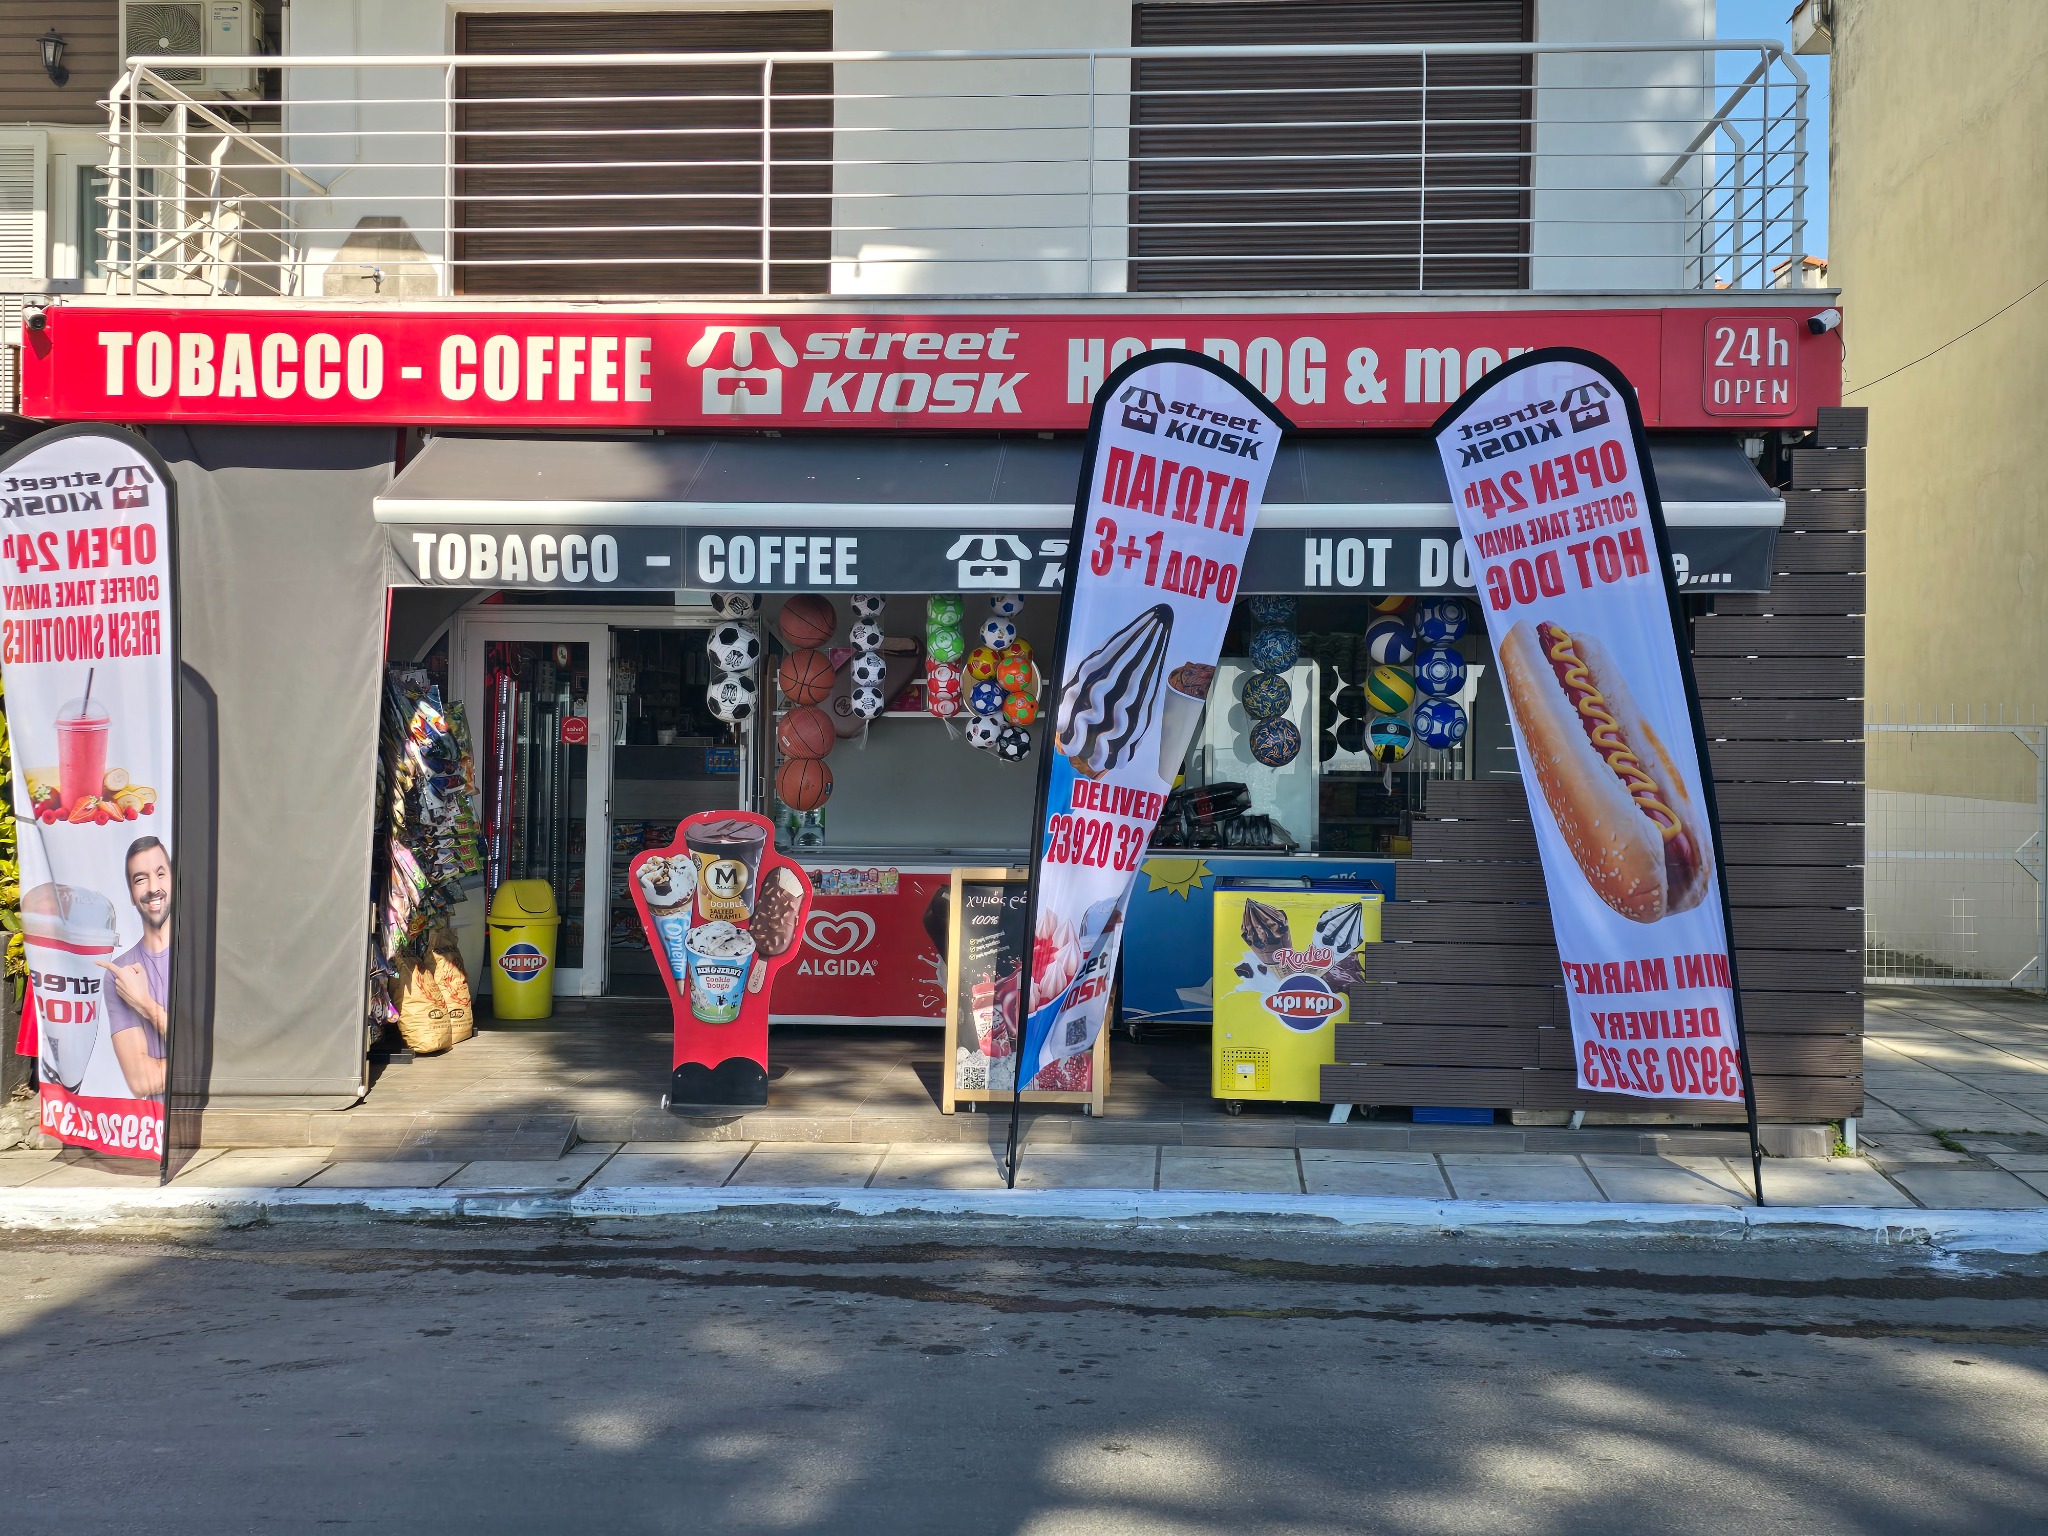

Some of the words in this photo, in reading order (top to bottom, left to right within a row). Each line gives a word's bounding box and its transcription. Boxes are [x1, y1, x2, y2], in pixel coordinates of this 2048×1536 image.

[803, 326, 1019, 360] street
[1714, 326, 1790, 368] 24h
[99, 330, 383, 400] TOBACCO
[440, 333, 652, 402] COFFEE
[1344, 347, 1387, 405] &
[802, 372, 1030, 414] KIOSK
[1713, 378, 1789, 405] OPEN
[1168, 400, 1262, 435] street
[1164, 419, 1264, 461] KIOSK
[1101, 446, 1250, 537] ΠΑΓΩΤΑ
[413, 533, 619, 583] TOBACCO
[698, 535, 858, 585] COFFEE
[1091, 516, 1165, 587] 3+1
[1161, 550, 1238, 604] ΔΩΡΟ
[1305, 538, 1392, 588] HOT
[1420, 538, 1477, 588] DO
[1071, 779, 1168, 822] DELIVER
[1047, 814, 1113, 869] 23920
[710, 900, 745, 908] DOUBLE
[971, 914, 999, 925] 100%
[797, 958, 876, 976] ALGIDA
[1274, 946, 1332, 969] Rodeo
